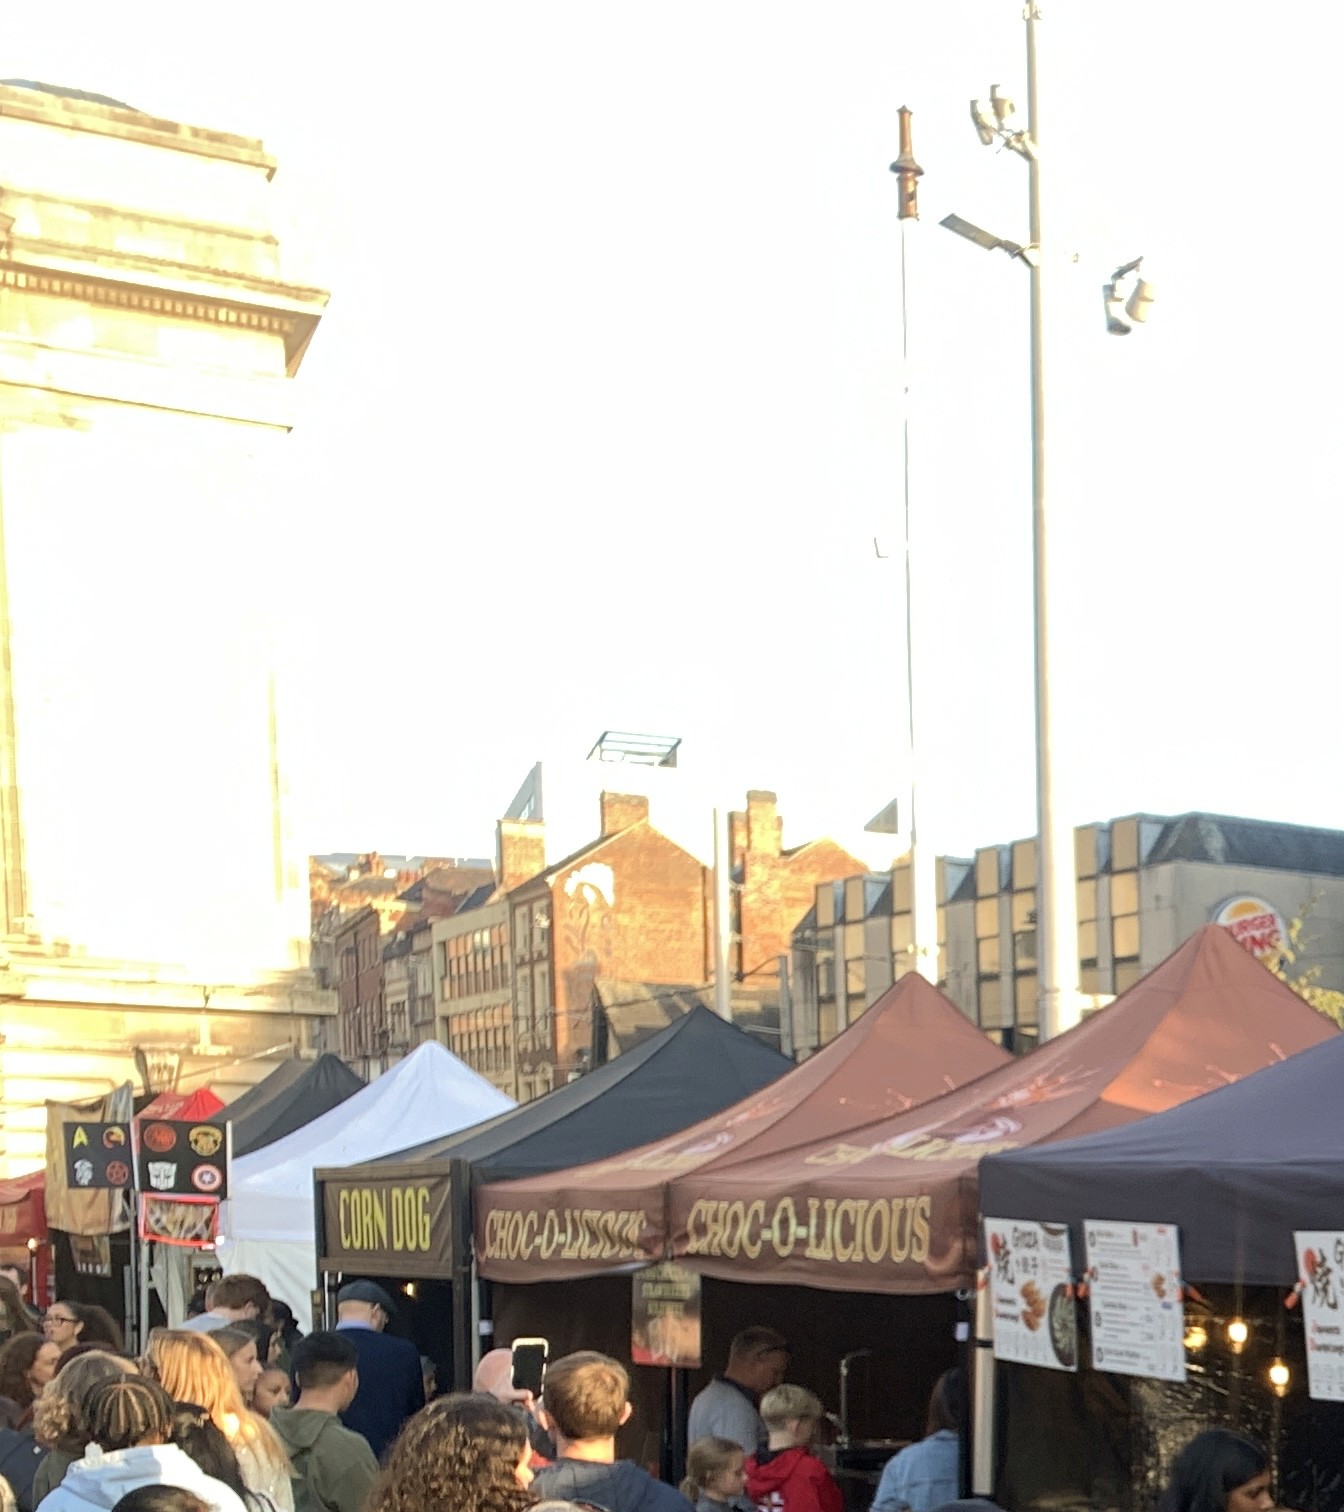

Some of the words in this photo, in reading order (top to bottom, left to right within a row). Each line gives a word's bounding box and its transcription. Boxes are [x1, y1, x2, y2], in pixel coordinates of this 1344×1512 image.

[339, 1188, 388, 1250] CORN
[391, 1186, 431, 1251] DOG
[686, 1195, 931, 1264] CHOC-O-LICIOUS
